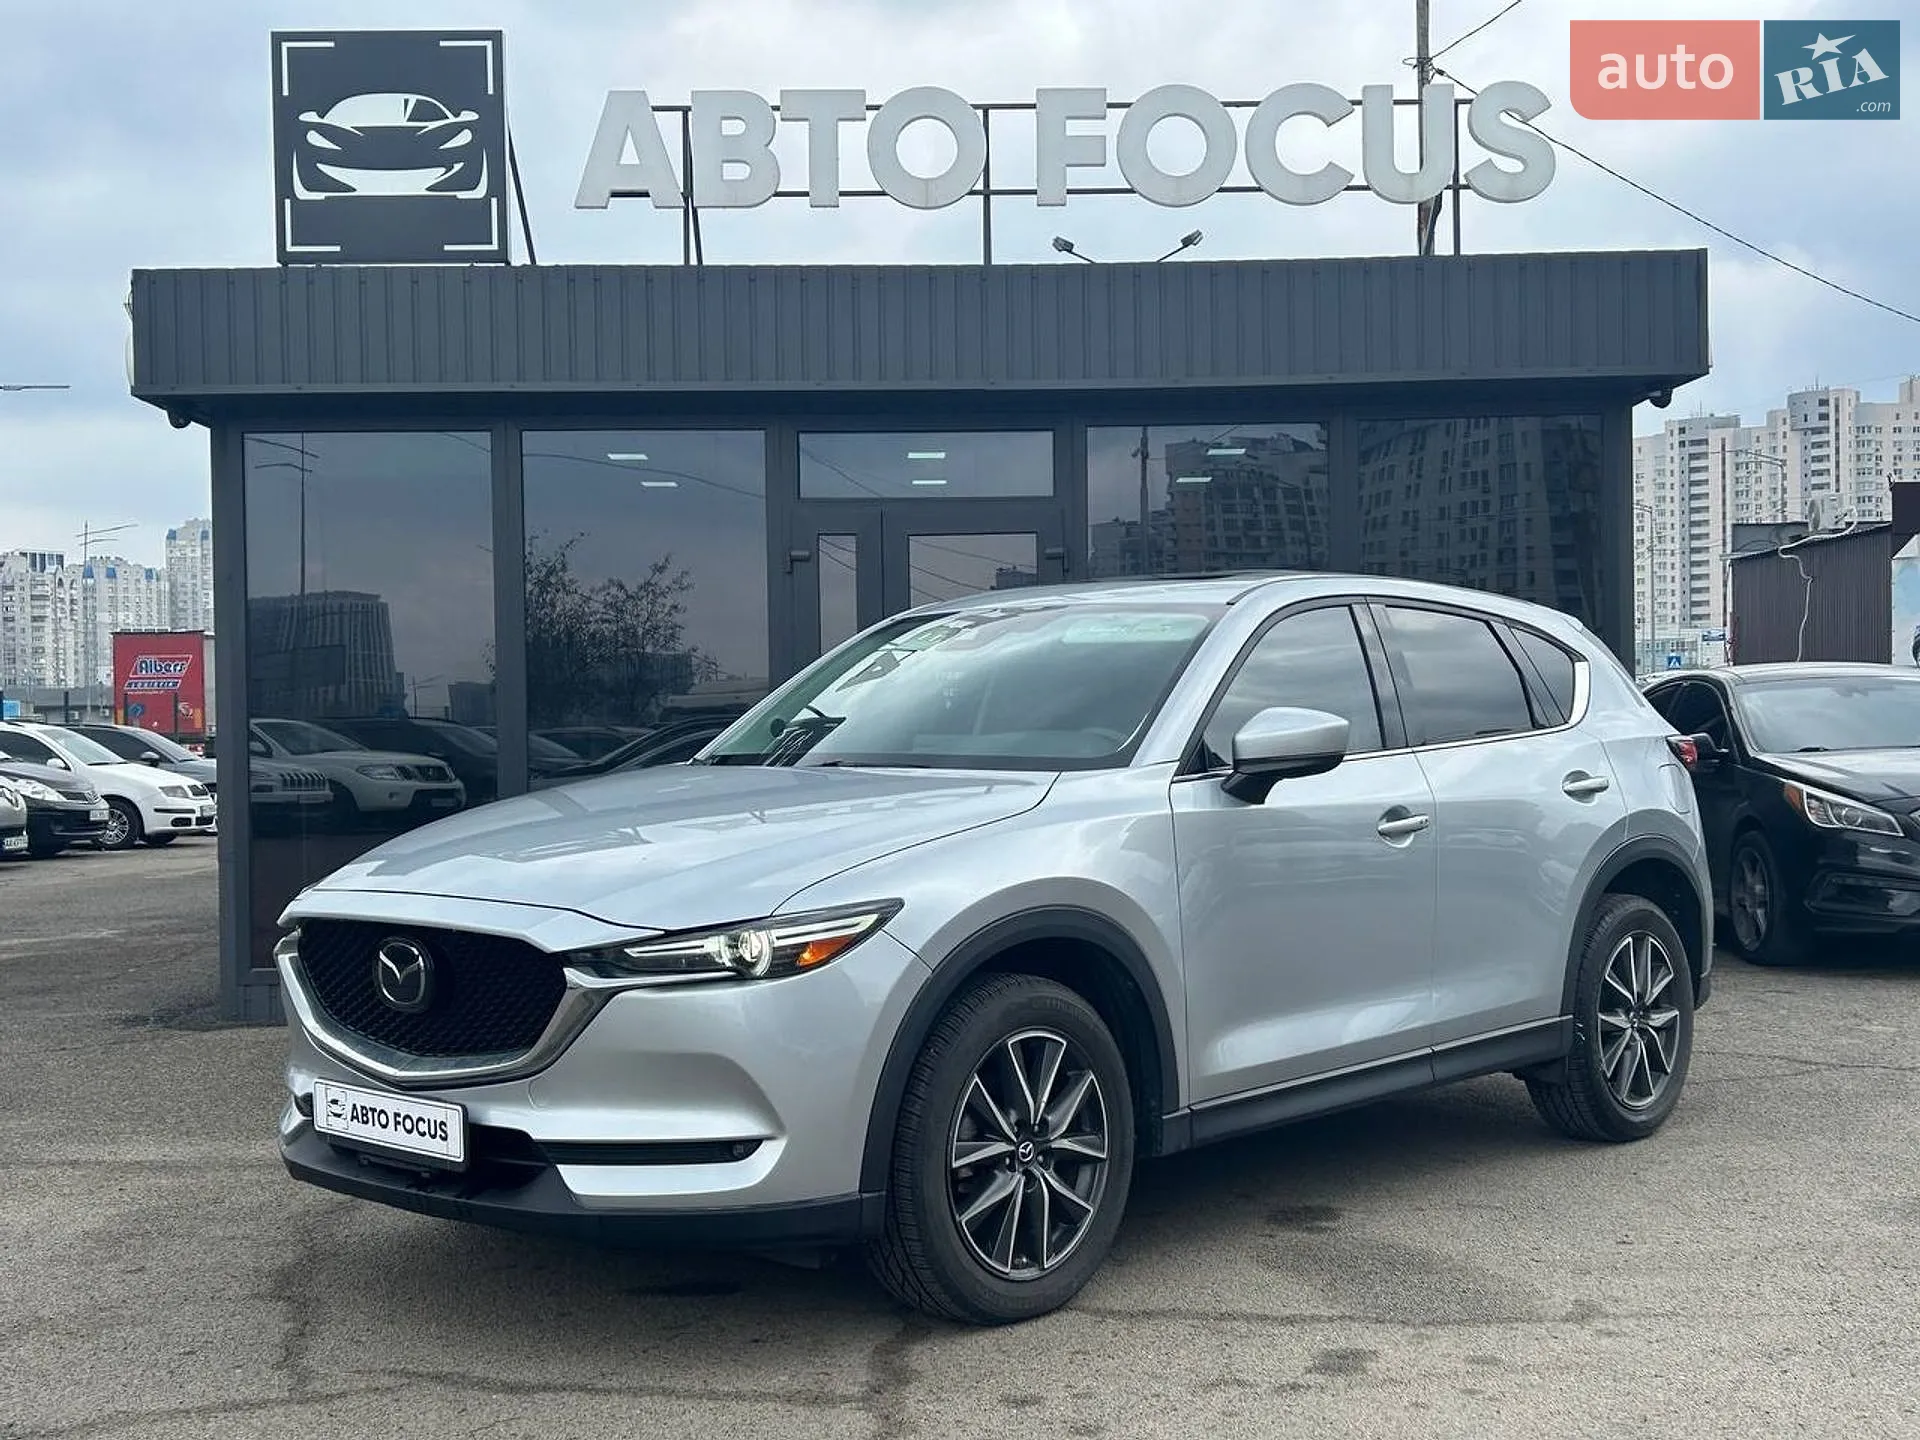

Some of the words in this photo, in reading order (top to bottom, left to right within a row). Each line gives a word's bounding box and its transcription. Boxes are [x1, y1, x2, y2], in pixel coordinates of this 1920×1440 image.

[574, 86, 989, 209] АВТО
[1036, 81, 1557, 208] FOCUS
[139, 659, 186, 675] Albers
[350, 1103, 390, 1129] АВТО
[394, 1113, 448, 1142] FOCUS
